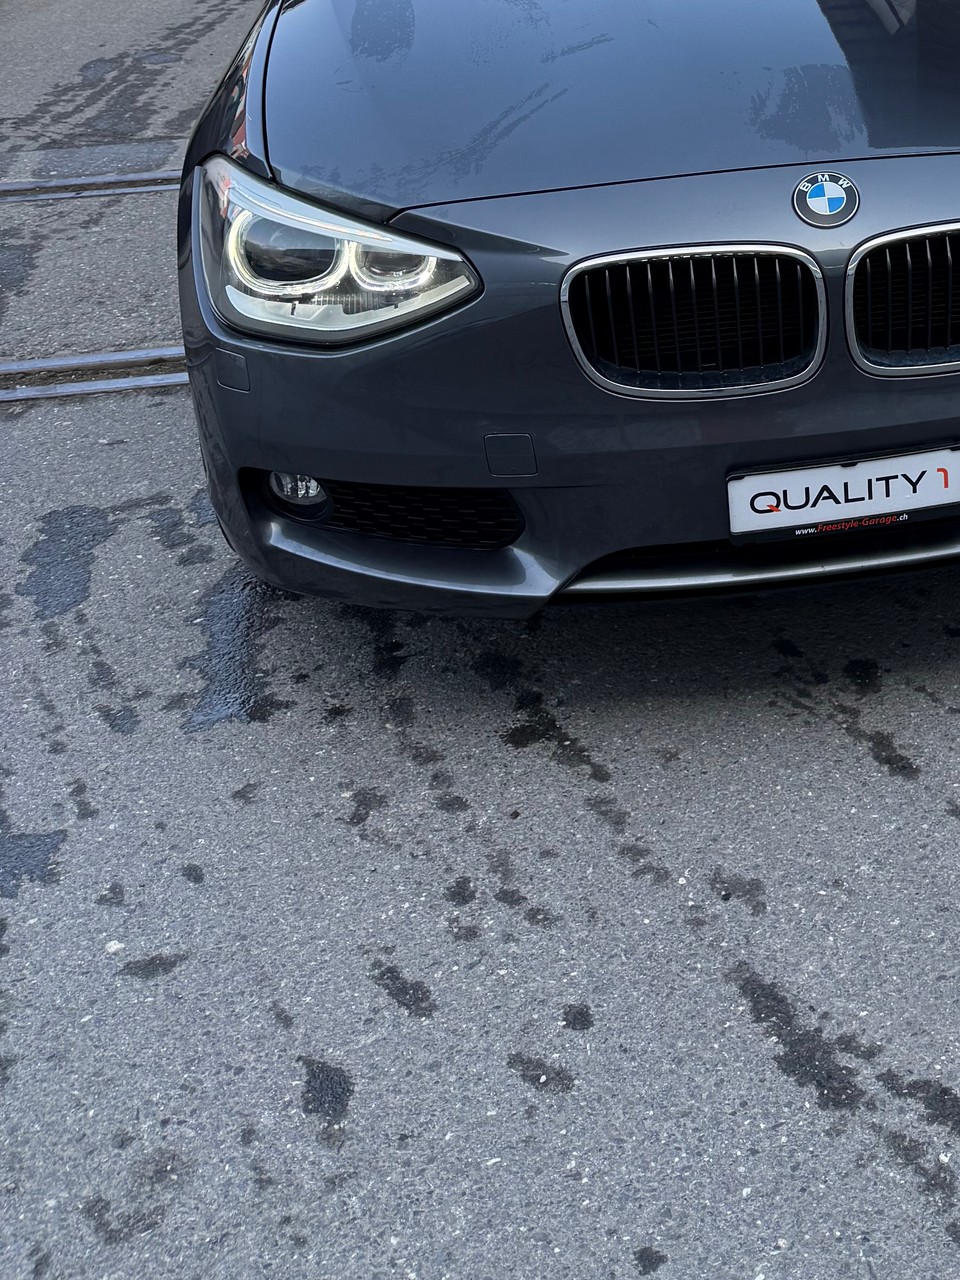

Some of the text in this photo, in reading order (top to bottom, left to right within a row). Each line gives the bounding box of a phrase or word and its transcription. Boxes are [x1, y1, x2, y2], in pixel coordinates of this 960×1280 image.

[800, 174, 851, 192] BMW
[749, 467, 949, 514] QUALITY 1
[795, 513, 909, 536] www.Freestyle-Garage.ch
